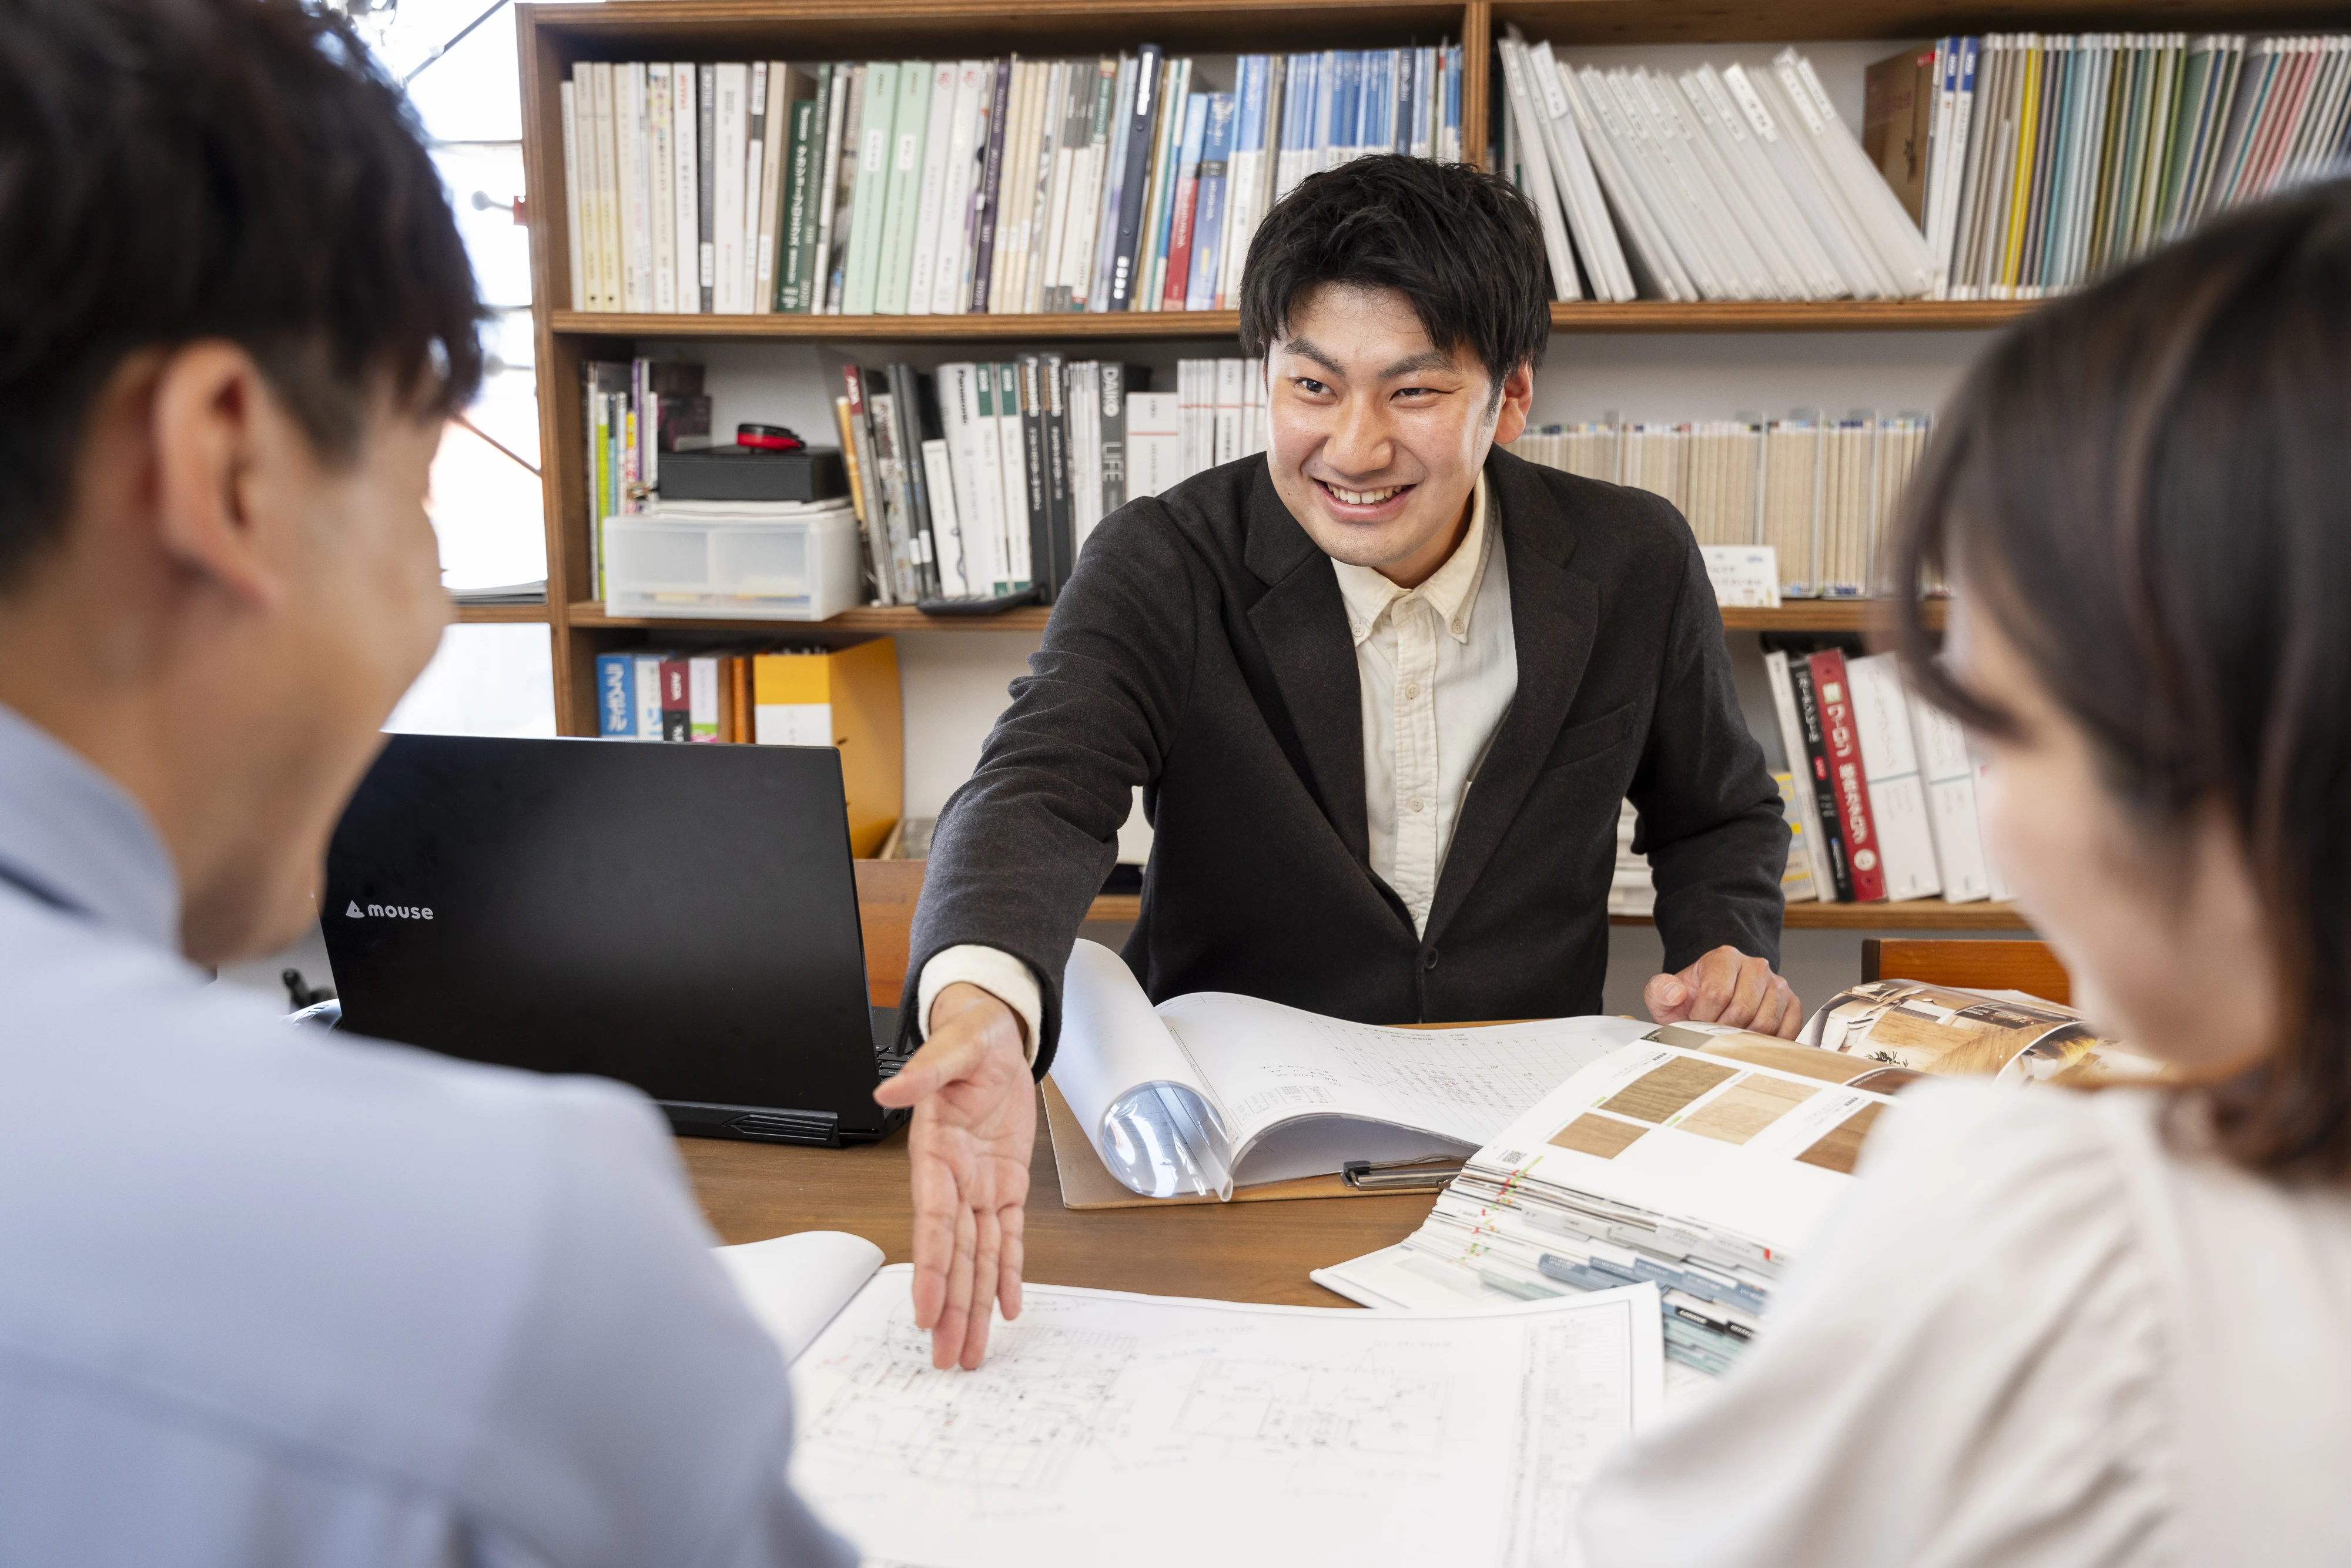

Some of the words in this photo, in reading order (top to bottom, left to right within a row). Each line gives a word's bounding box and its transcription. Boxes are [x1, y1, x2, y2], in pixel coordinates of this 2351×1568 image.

[1101, 366, 1120, 418] DAIKO
[1101, 441, 1123, 483] LIFE
[367, 904, 434, 920] mouse
